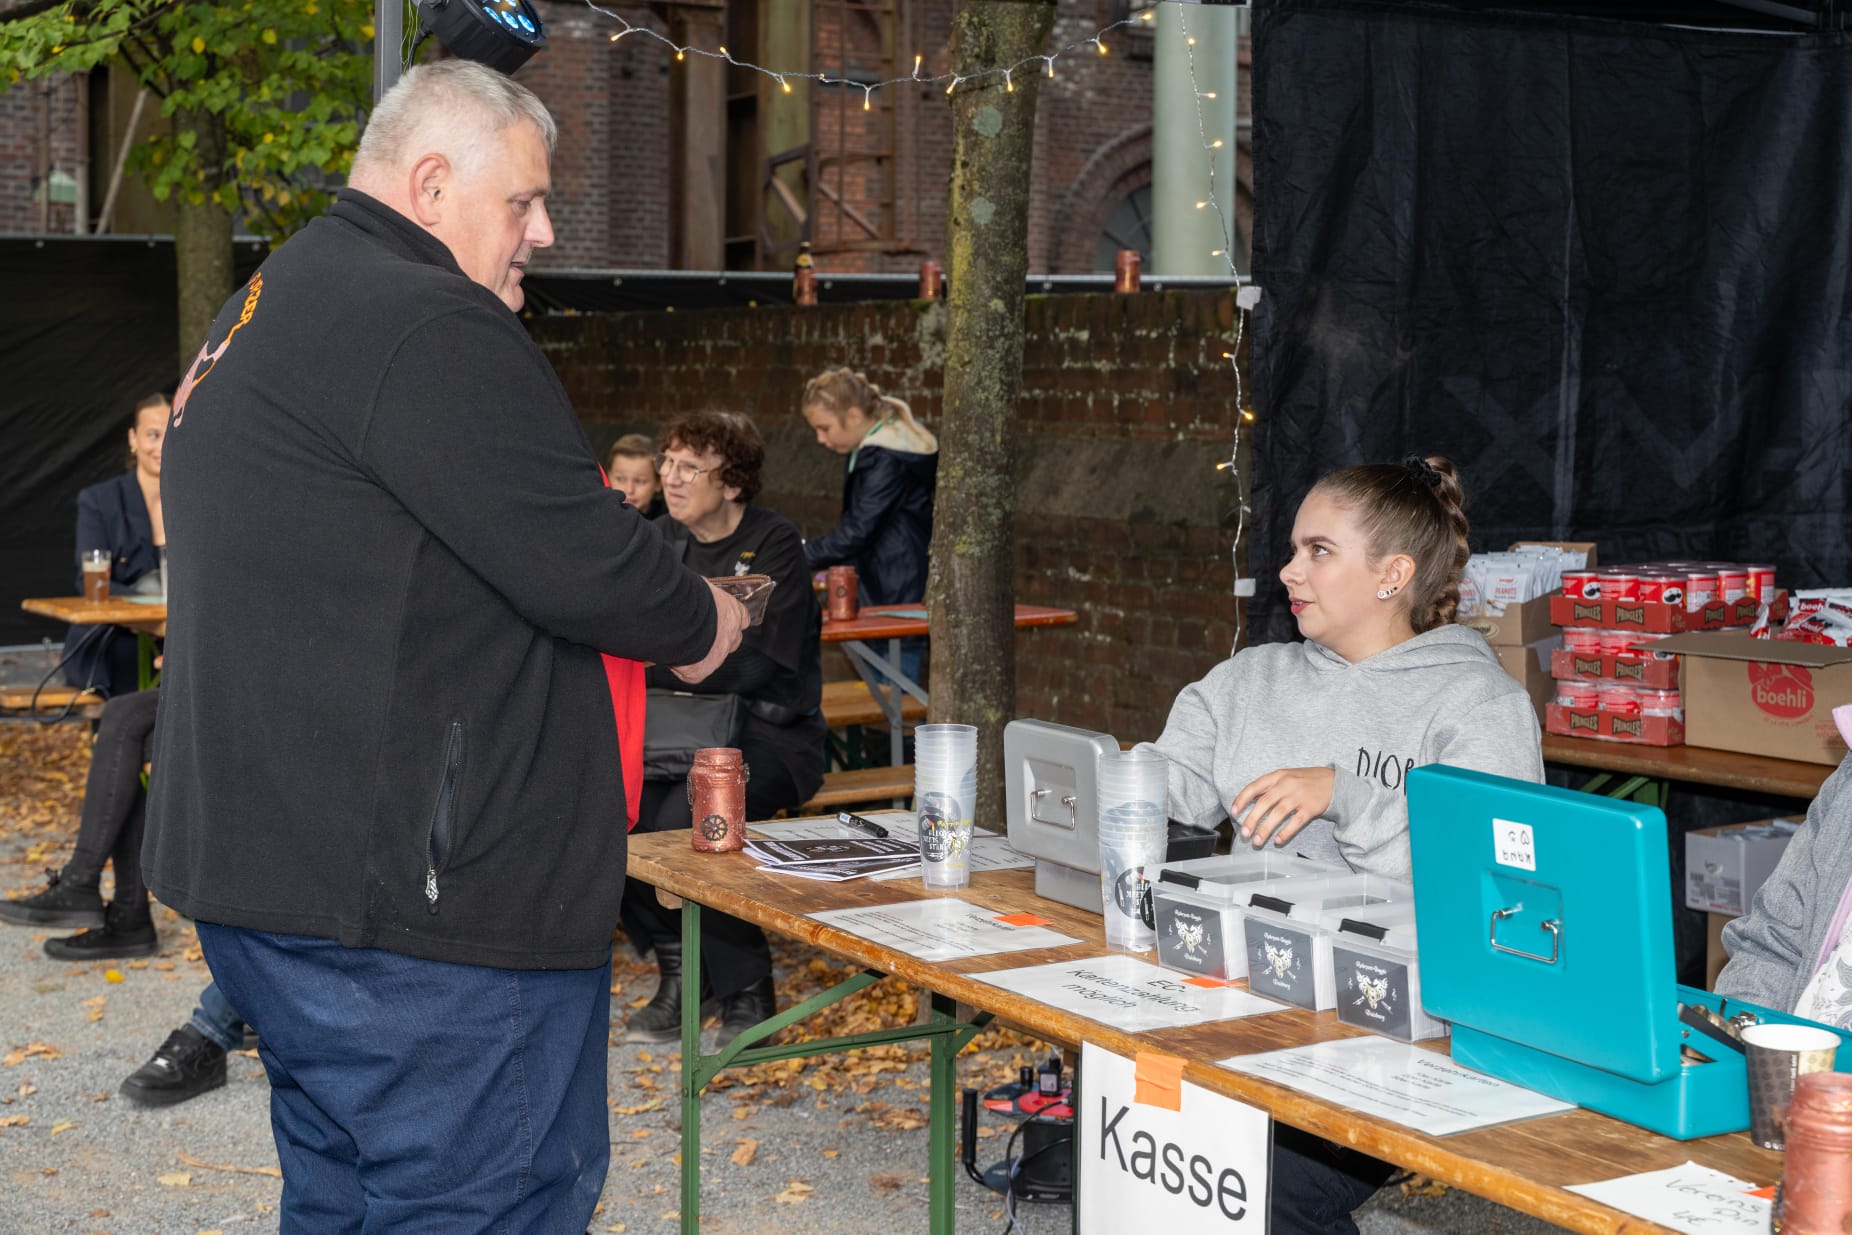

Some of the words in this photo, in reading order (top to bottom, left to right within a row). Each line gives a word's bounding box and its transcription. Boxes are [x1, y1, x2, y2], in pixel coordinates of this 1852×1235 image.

[1574, 603, 1601, 622] PRINGLES
[1616, 606, 1644, 625] PRINGLES
[1757, 684, 1807, 709] boehli
[1060, 983, 1137, 1008] möglich
[1066, 969, 1200, 1013] Kartenzahlung
[1148, 979, 1186, 993] EC-
[1100, 1095, 1248, 1222] Kasse
